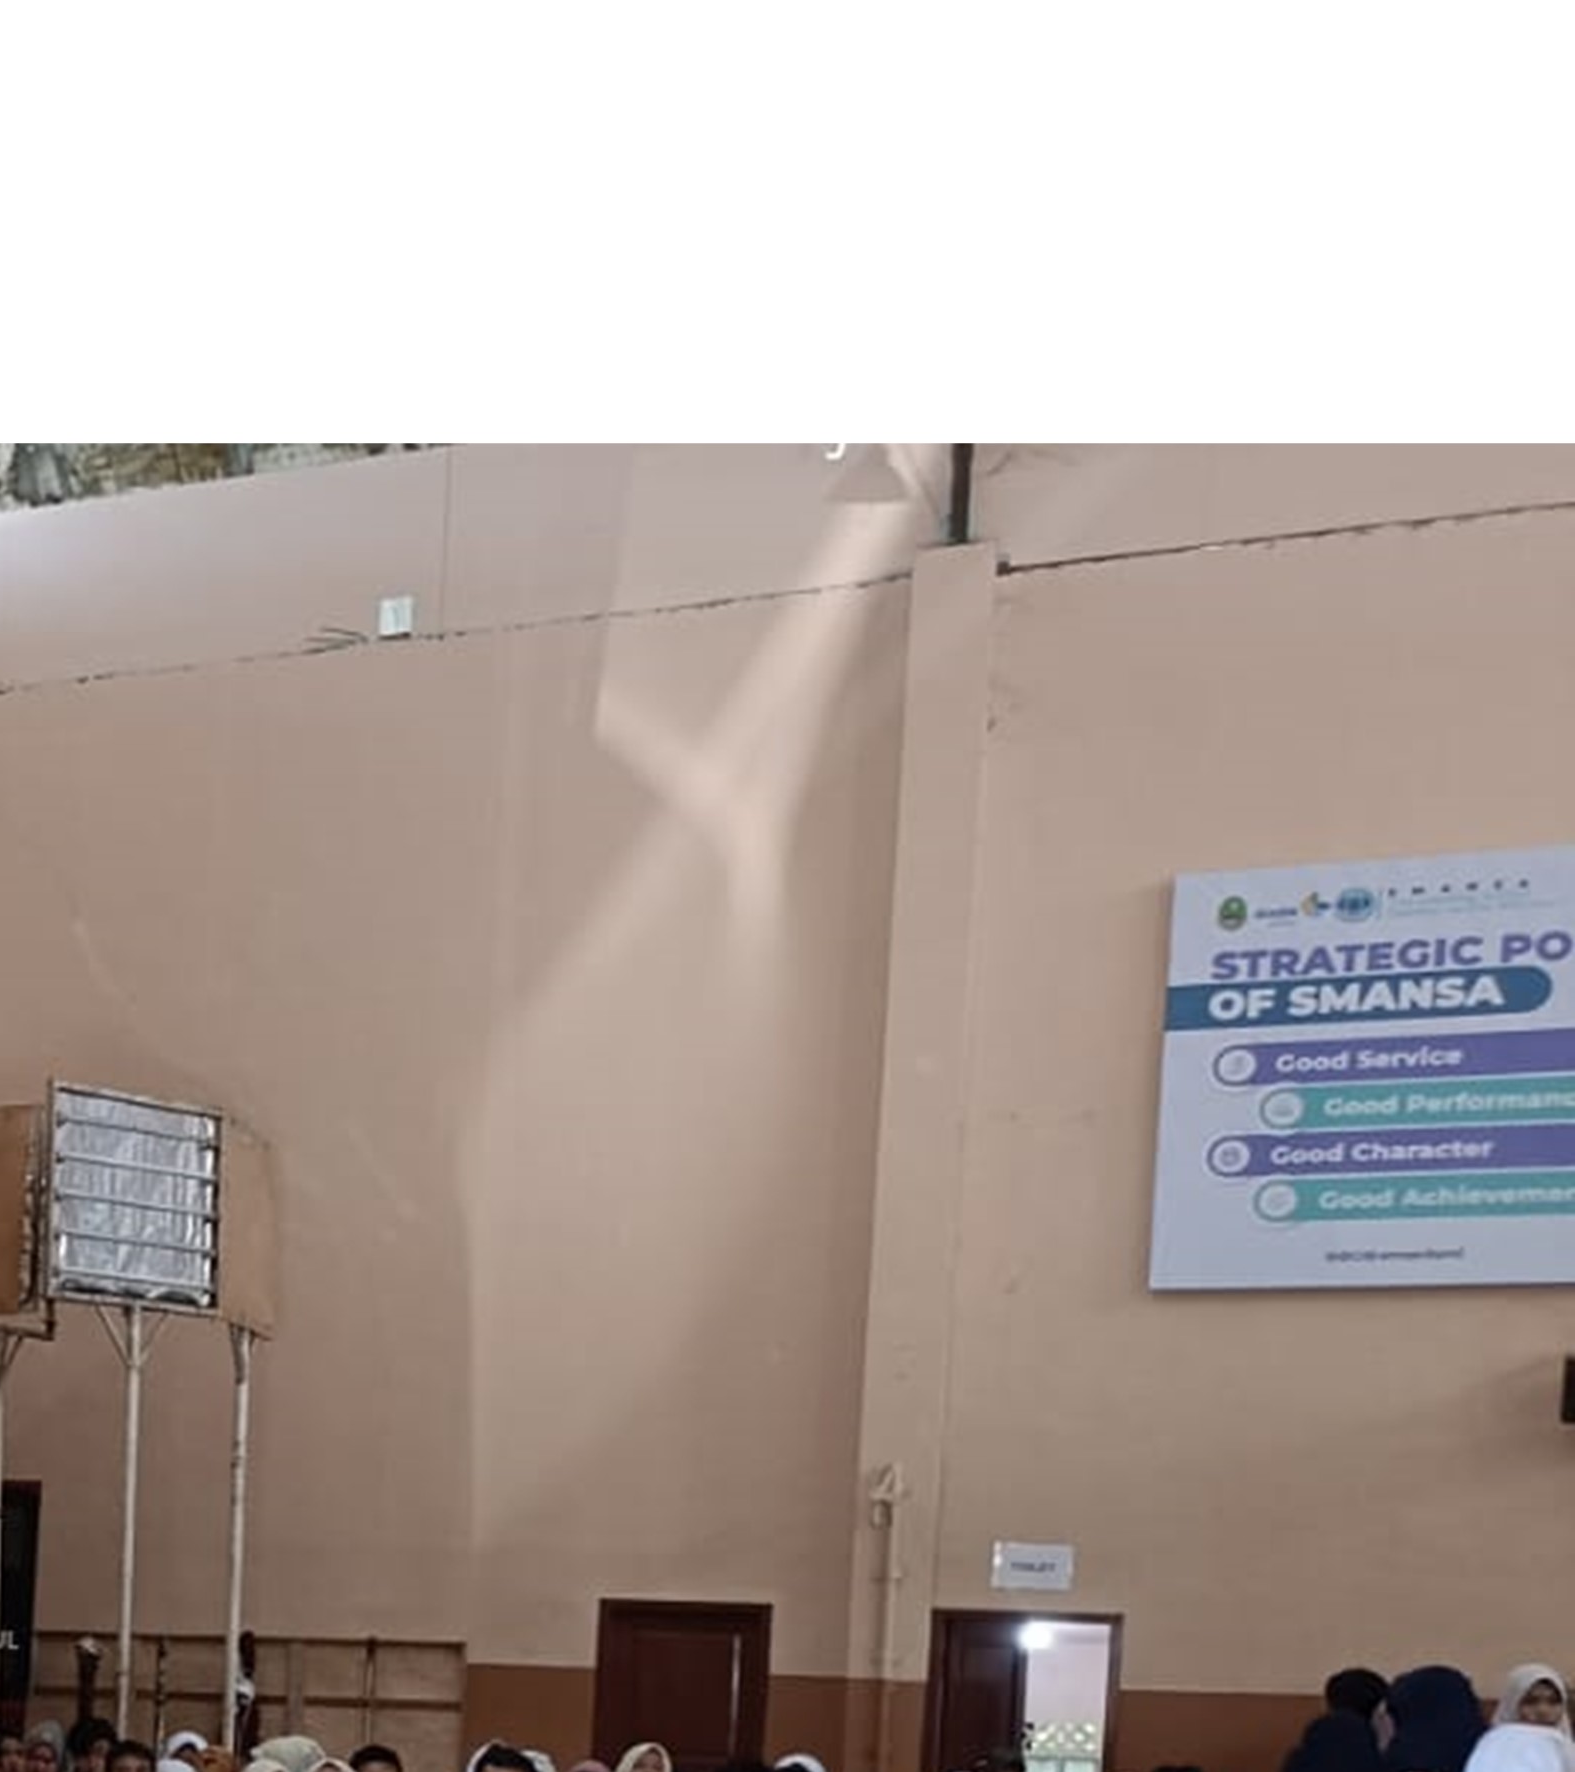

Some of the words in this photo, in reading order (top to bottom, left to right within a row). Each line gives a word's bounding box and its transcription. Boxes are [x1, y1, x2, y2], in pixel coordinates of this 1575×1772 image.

[1210, 936, 1484, 981] STRATEGIC
[1207, 988, 1278, 1021] OF
[1288, 977, 1504, 1015] SMANSA
[1275, 1051, 1350, 1073] Good
[1356, 1045, 1464, 1070] Service
[1323, 1095, 1400, 1118] Good
[1269, 1143, 1346, 1166] Good
[1351, 1140, 1495, 1162] Character
[1318, 1188, 1395, 1211] Good
